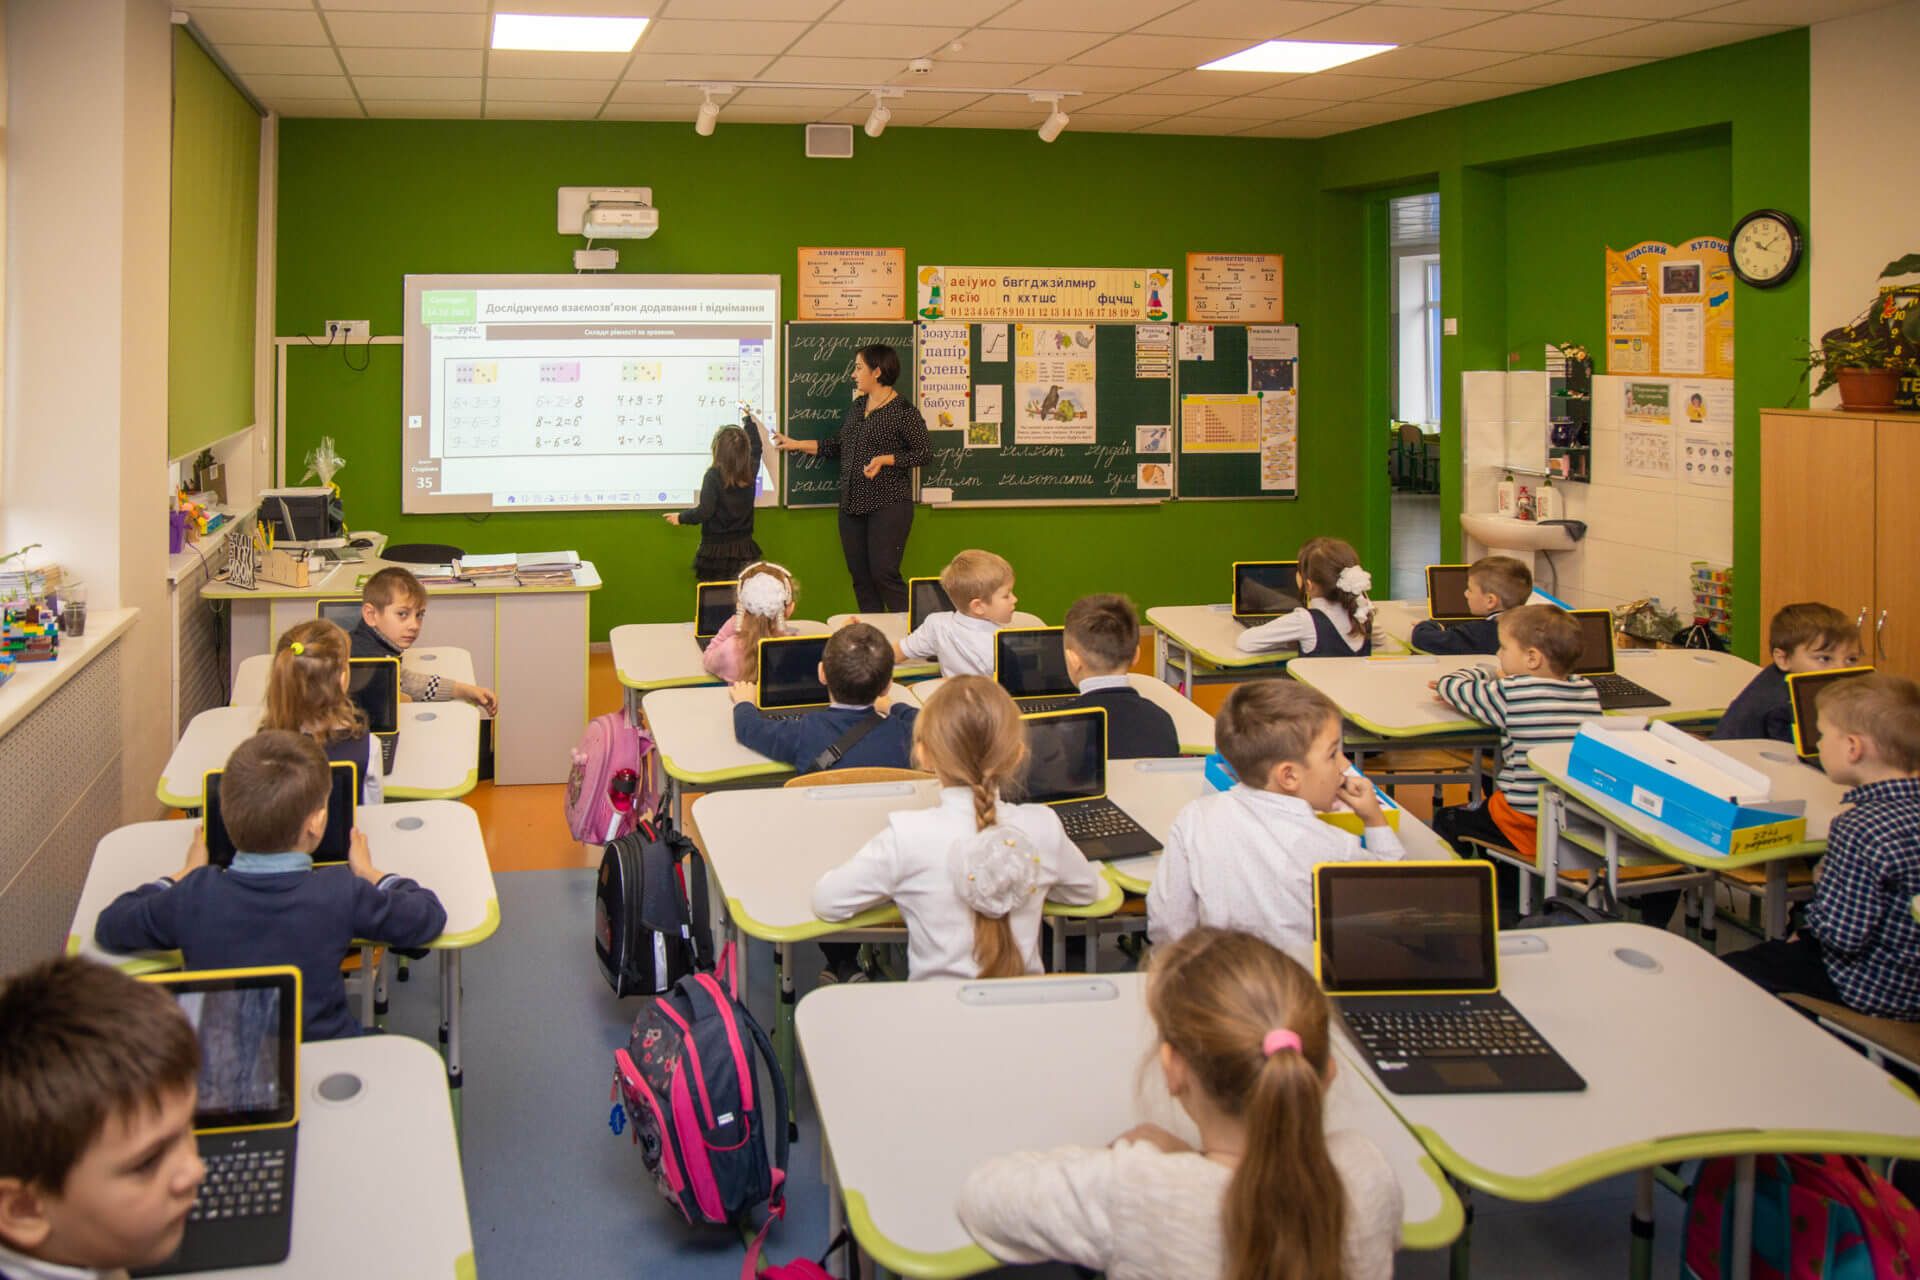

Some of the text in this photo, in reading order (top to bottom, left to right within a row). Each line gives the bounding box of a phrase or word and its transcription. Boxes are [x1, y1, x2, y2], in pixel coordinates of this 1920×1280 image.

[1625, 240, 1729, 260] КЛАСНИЙ КУТОЧО
[850, 266, 855, 274] 3
[886, 266, 892, 274] 8
[1265, 273, 1274, 281] 12
[486, 303, 559, 315] Досліджуємо
[640, 303, 697, 314] додавання
[700, 302, 703, 311] і
[706, 302, 765, 314] віднімання
[1267, 302, 1272, 310] 7
[923, 330, 967, 340] зозуля
[926, 345, 966, 359] папір
[924, 366, 967, 375] олень
[923, 384, 967, 392] виразно
[924, 397, 965, 409] бабуся
[416, 477, 433, 488] 35
